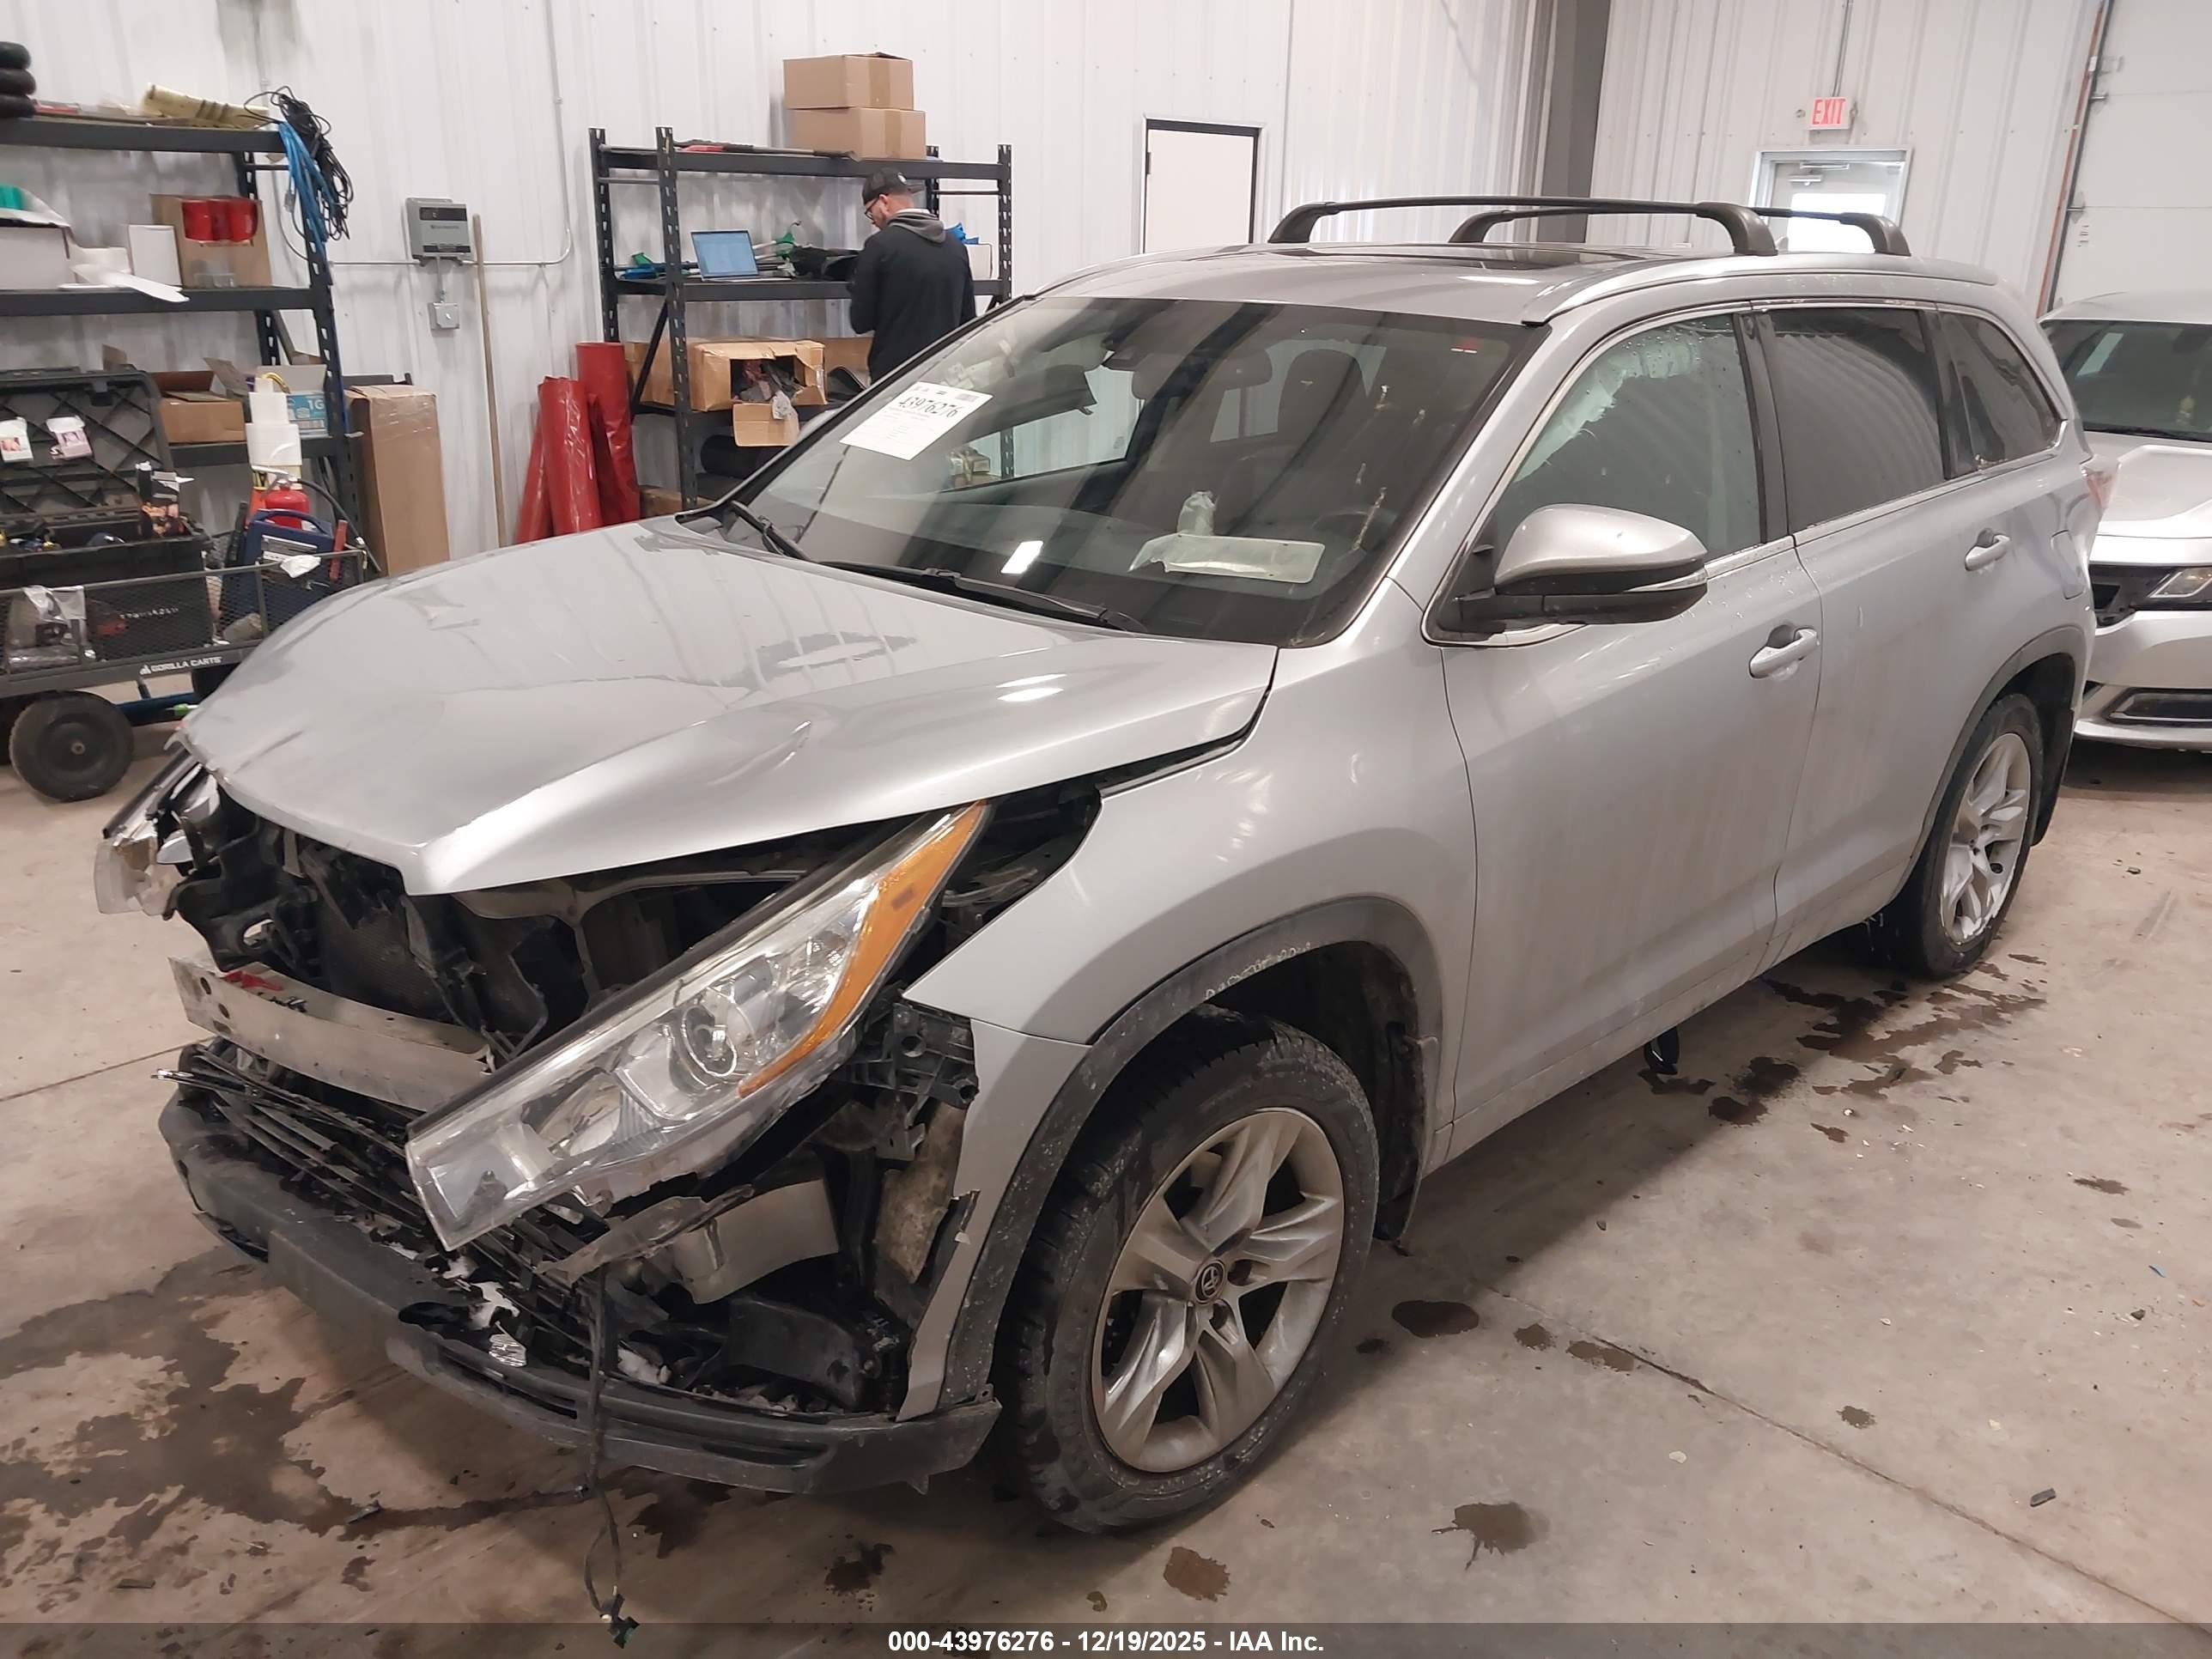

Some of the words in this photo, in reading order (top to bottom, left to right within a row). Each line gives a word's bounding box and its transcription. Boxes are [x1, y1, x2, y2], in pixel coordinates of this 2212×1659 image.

[1812, 98, 1846, 125] EXIT
[899, 396, 963, 418] 43976276
[150, 660, 190, 673] GORILLA
[190, 656, 222, 668] CARTS
